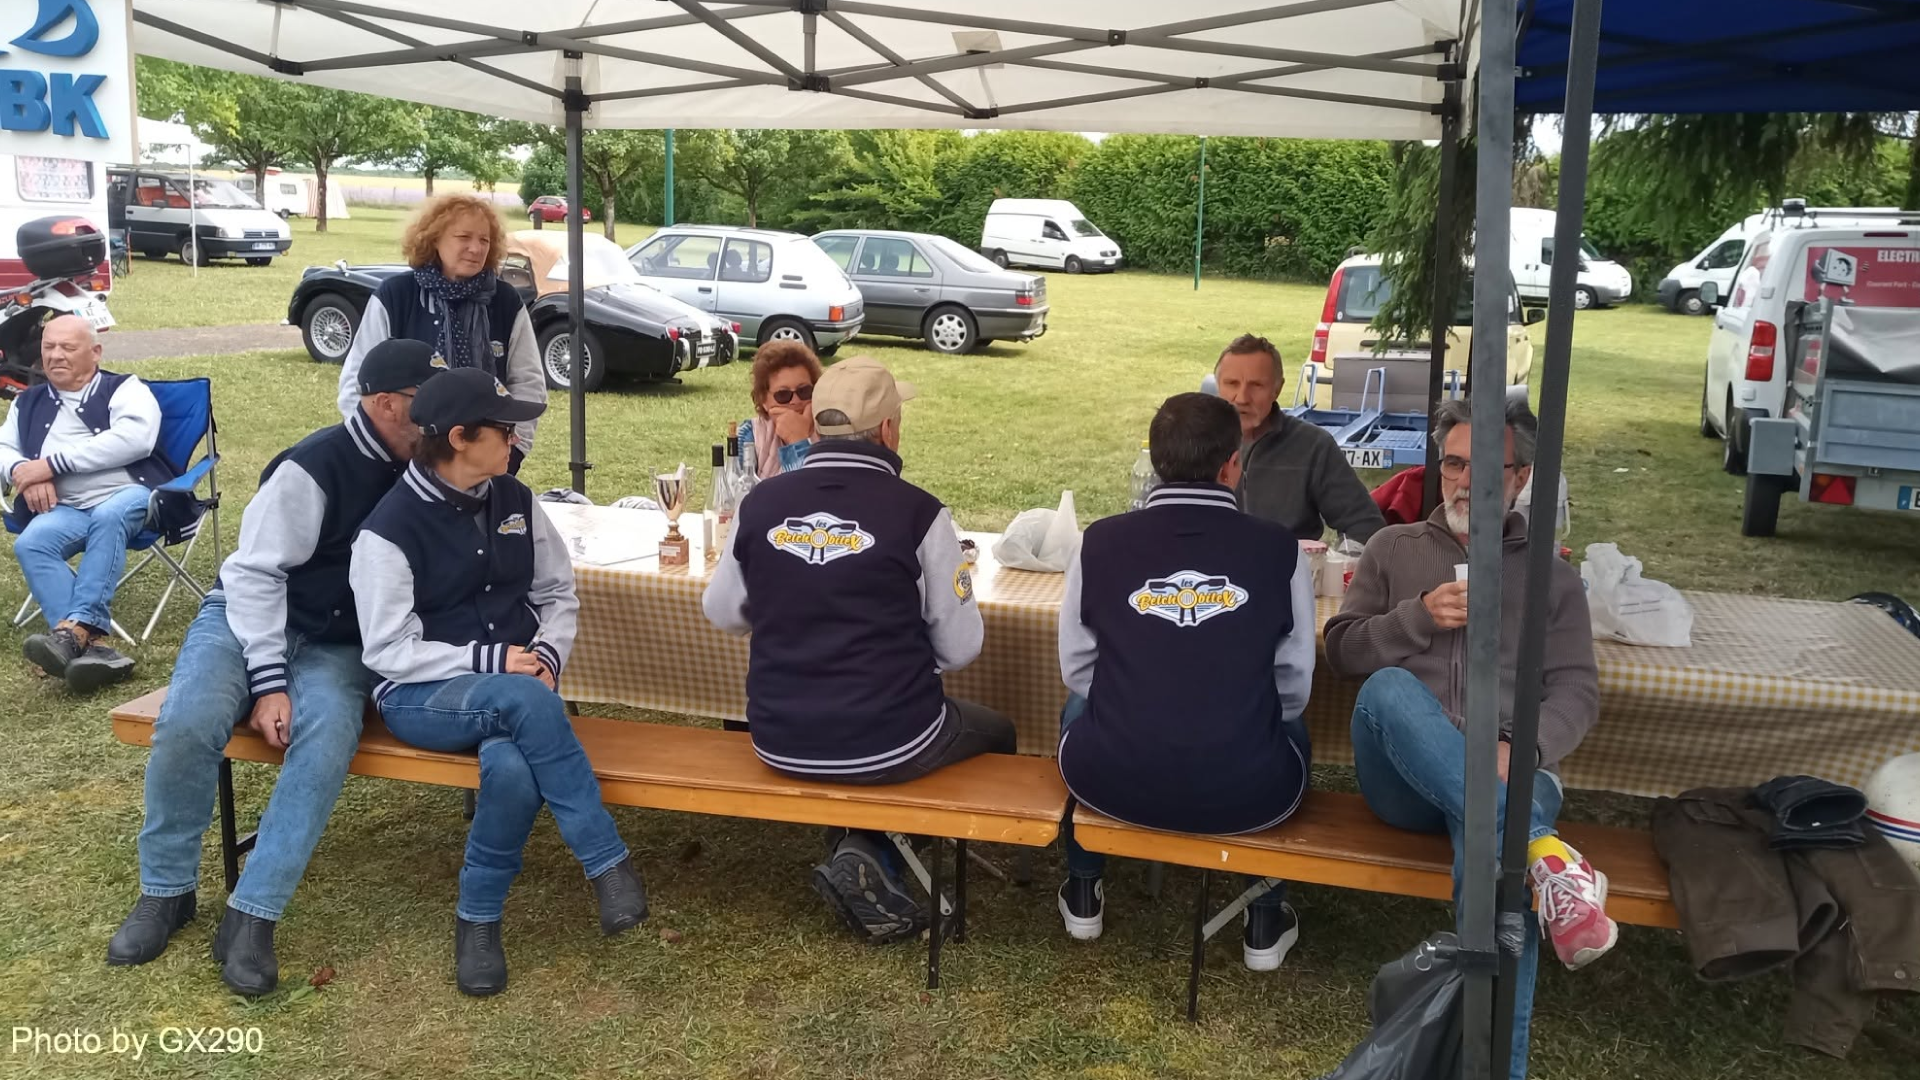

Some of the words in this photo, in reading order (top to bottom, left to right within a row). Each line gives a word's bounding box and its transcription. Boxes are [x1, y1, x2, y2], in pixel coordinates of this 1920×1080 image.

[0, 69, 109, 139] BK
[1344, 450, 1380, 466] 7-AX
[1180, 578, 1193, 587] les
